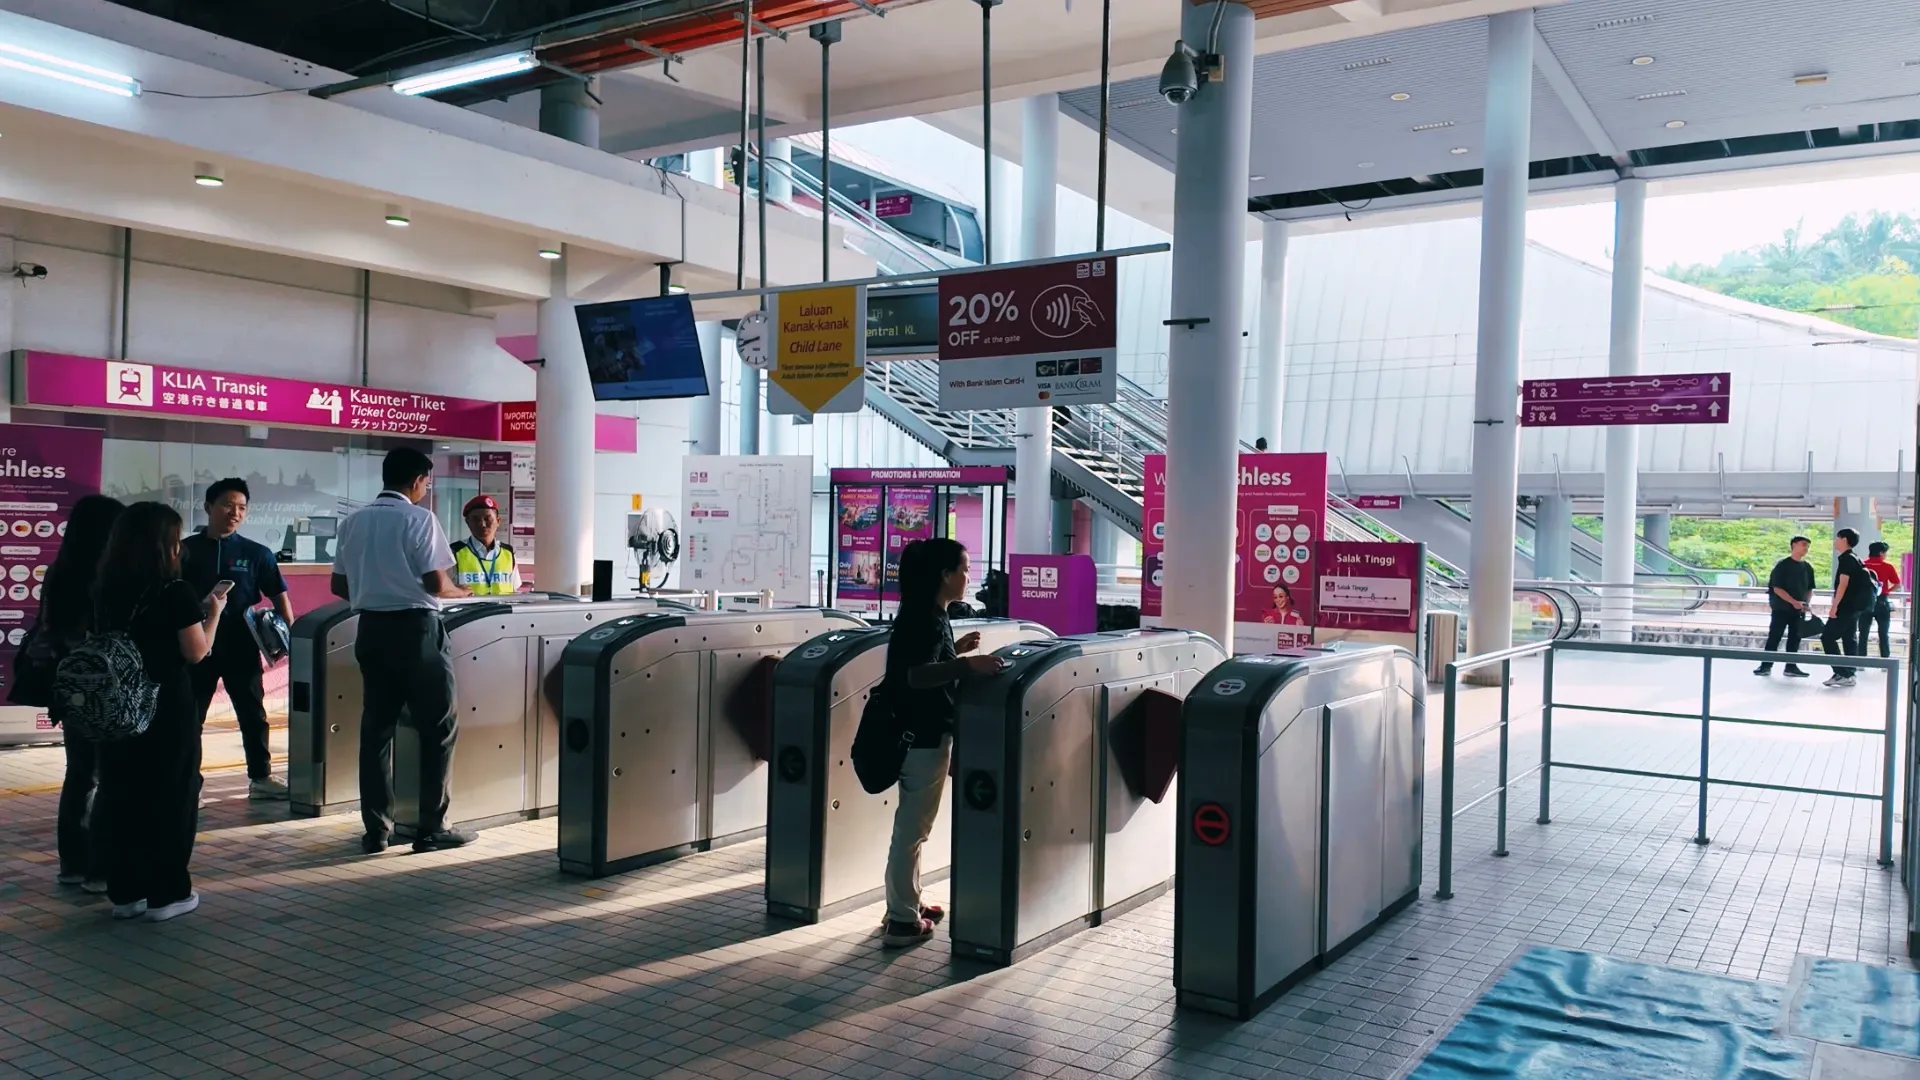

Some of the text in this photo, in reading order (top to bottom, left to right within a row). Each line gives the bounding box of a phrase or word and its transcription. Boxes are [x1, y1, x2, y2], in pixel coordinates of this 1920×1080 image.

[799, 302, 832, 317] Laluan
[948, 290, 1019, 326] 20%
[783, 318, 849, 333] Kanak-kanak
[866, 325, 916, 336] entral KL
[948, 330, 980, 346] OFF
[1004, 334, 1020, 343] gate
[790, 340, 842, 354] Child Lane
[162, 371, 268, 397] KLIA Transit
[1055, 380, 1102, 390] BANK ISLAM
[1531, 388, 1558, 398] 1 & 2
[162, 392, 268, 412] 空港行き普通電車
[350, 388, 446, 412] Kaunter Tiket
[350, 404, 431, 422] Ticket Counter
[504, 412, 537, 420] IMPORTAN
[1529, 412, 1556, 422] 3 & 4
[350, 418, 437, 434] チケットカウンター
[510, 422, 536, 431] NOTICE
[0, 447, 17, 457] re
[871, 470, 960, 479] PROMOTIONS & INFORMATION
[1154, 472, 1166, 485] W
[1238, 467, 1292, 486] hless
[1336, 554, 1396, 566] Salak Tinggi
[1022, 590, 1058, 599] SECURITY
